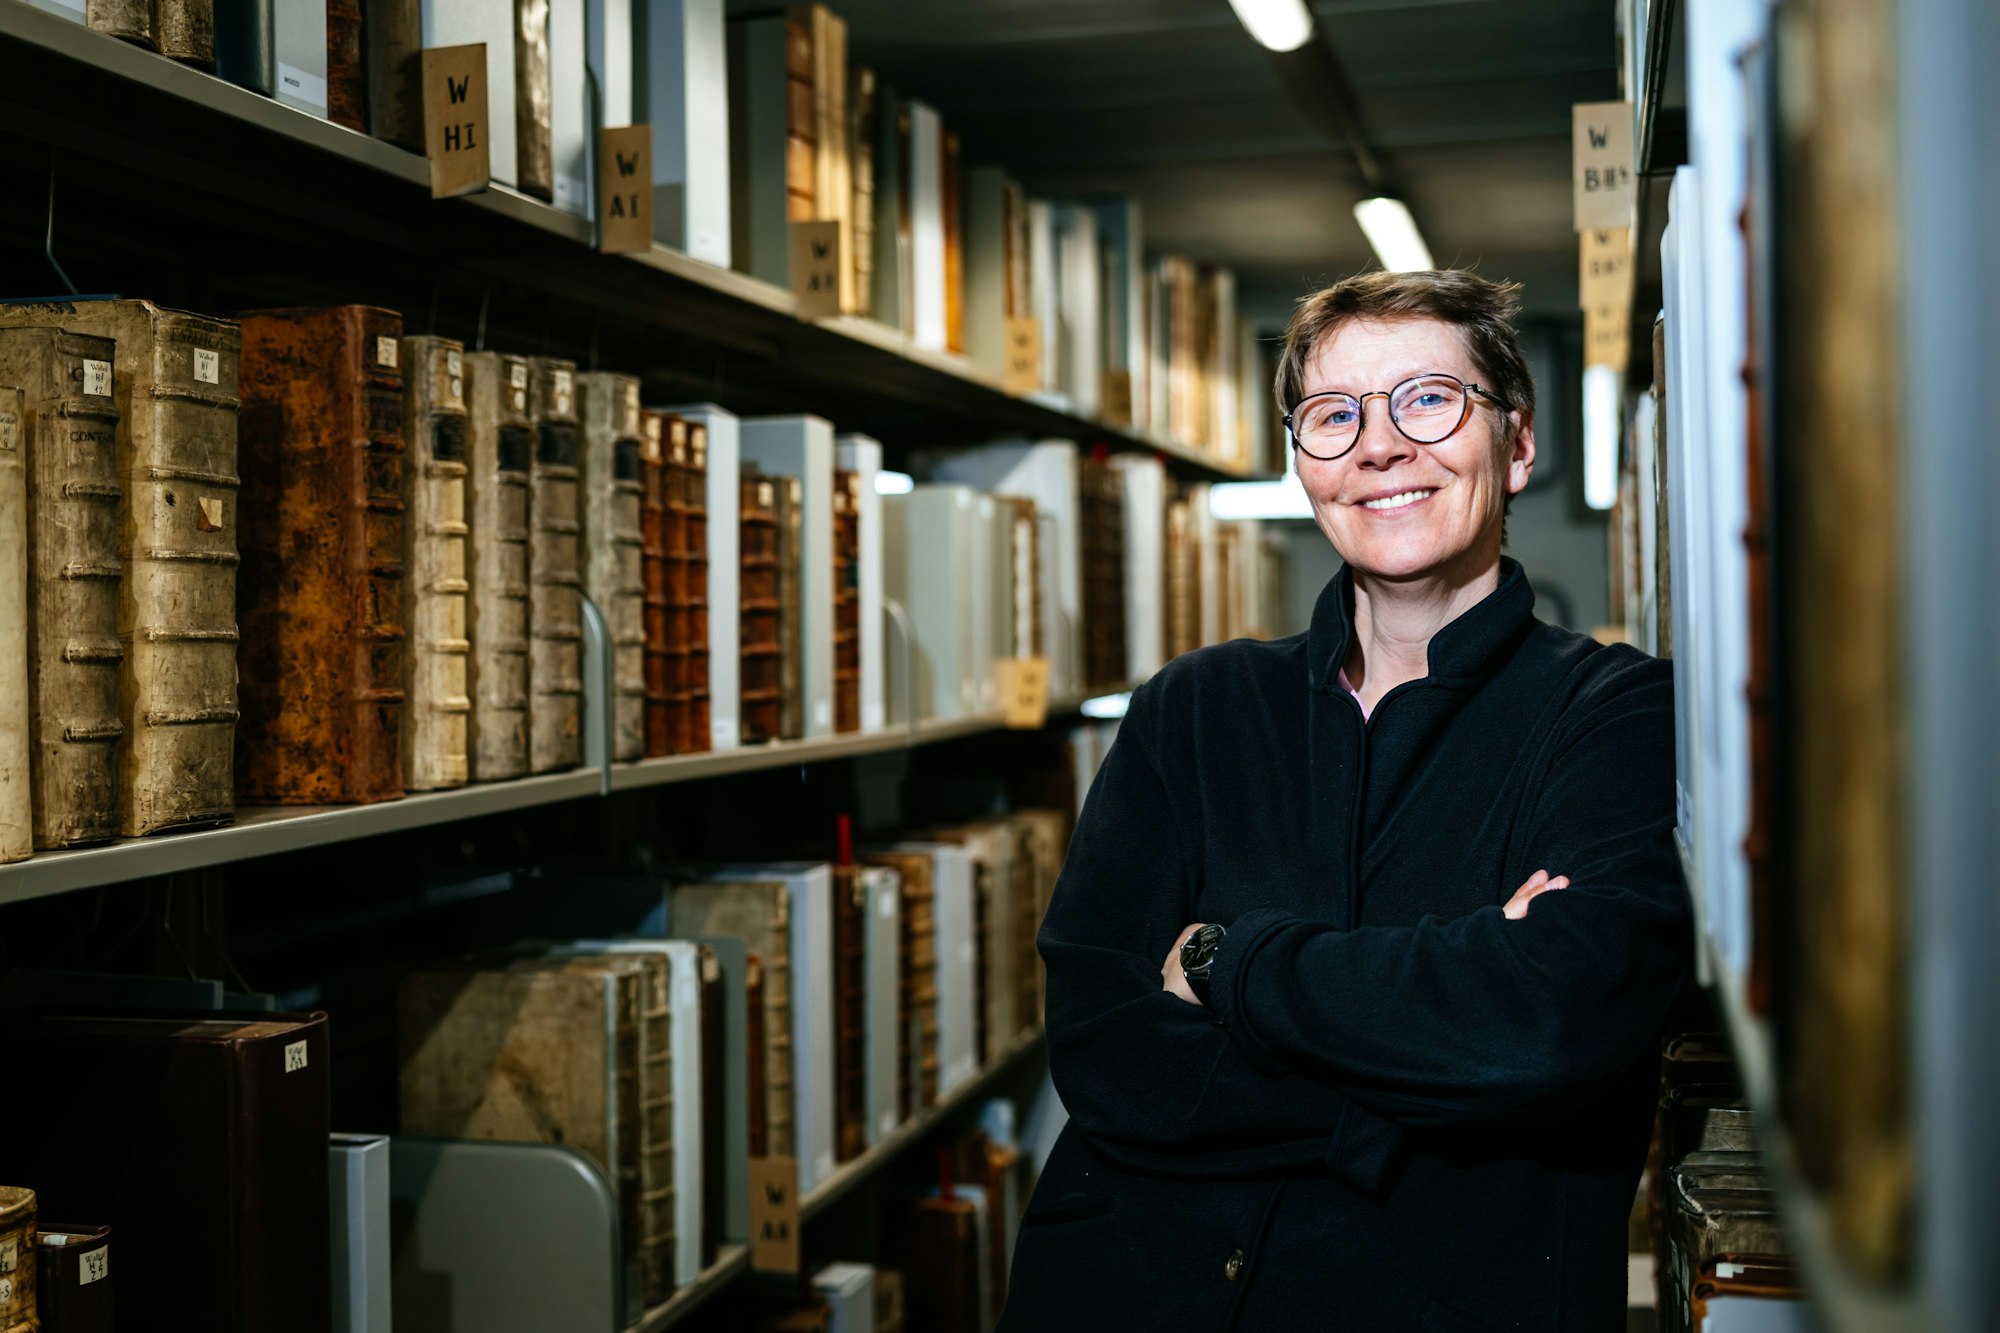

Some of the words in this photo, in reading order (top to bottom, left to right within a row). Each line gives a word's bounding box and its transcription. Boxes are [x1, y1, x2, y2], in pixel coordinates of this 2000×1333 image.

[447, 75, 470, 105] W
[444, 122, 477, 153] HI
[1587, 124, 1610, 152] W
[615, 151, 640, 178] W
[94, 385, 104, 395] 12
